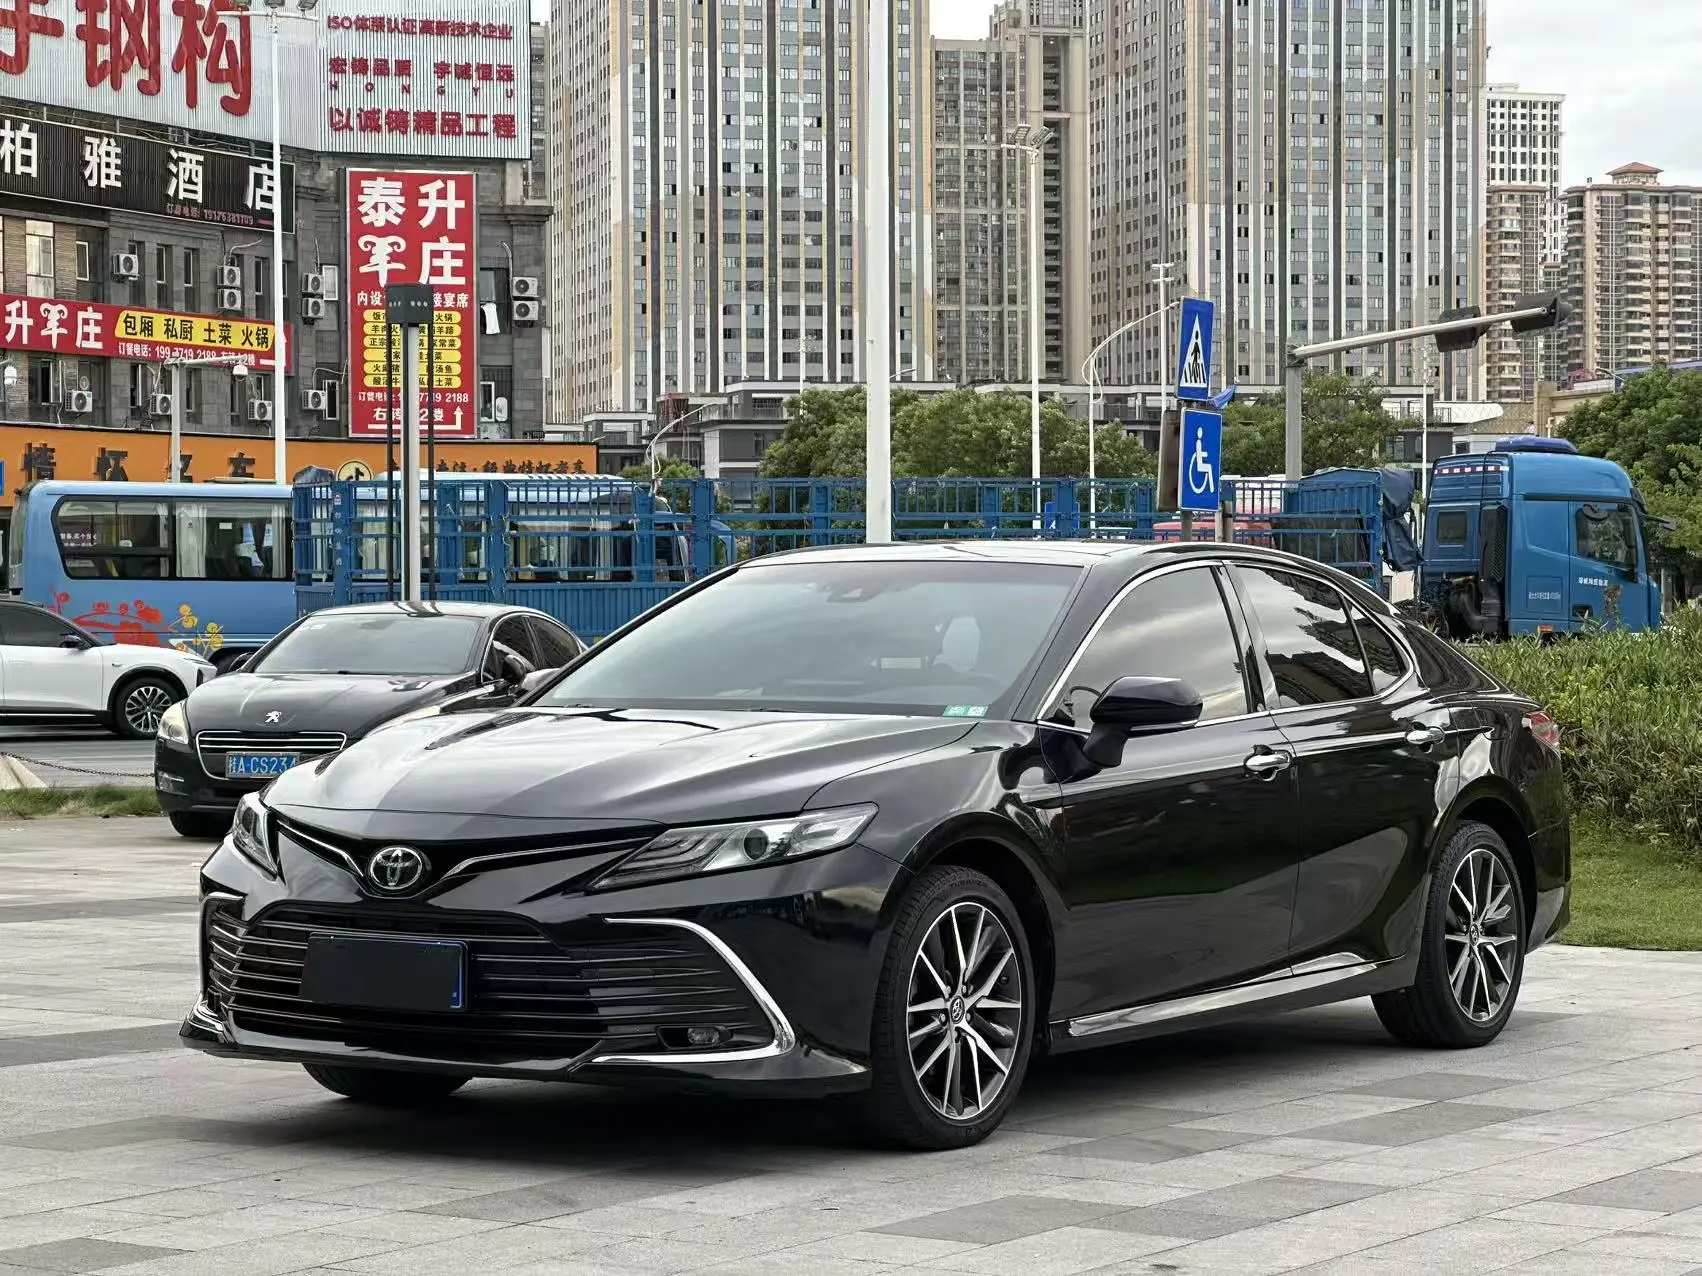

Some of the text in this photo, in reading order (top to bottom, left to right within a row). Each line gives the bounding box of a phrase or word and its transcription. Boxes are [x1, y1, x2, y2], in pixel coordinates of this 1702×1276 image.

[357, 176, 465, 229] 泰升
[123, 313, 269, 349] 包厢 私厨 土菜 火锅
[155, 346, 170, 359] 199
[196, 349, 217, 360] 2188
[445, 392, 469, 403] 2188
